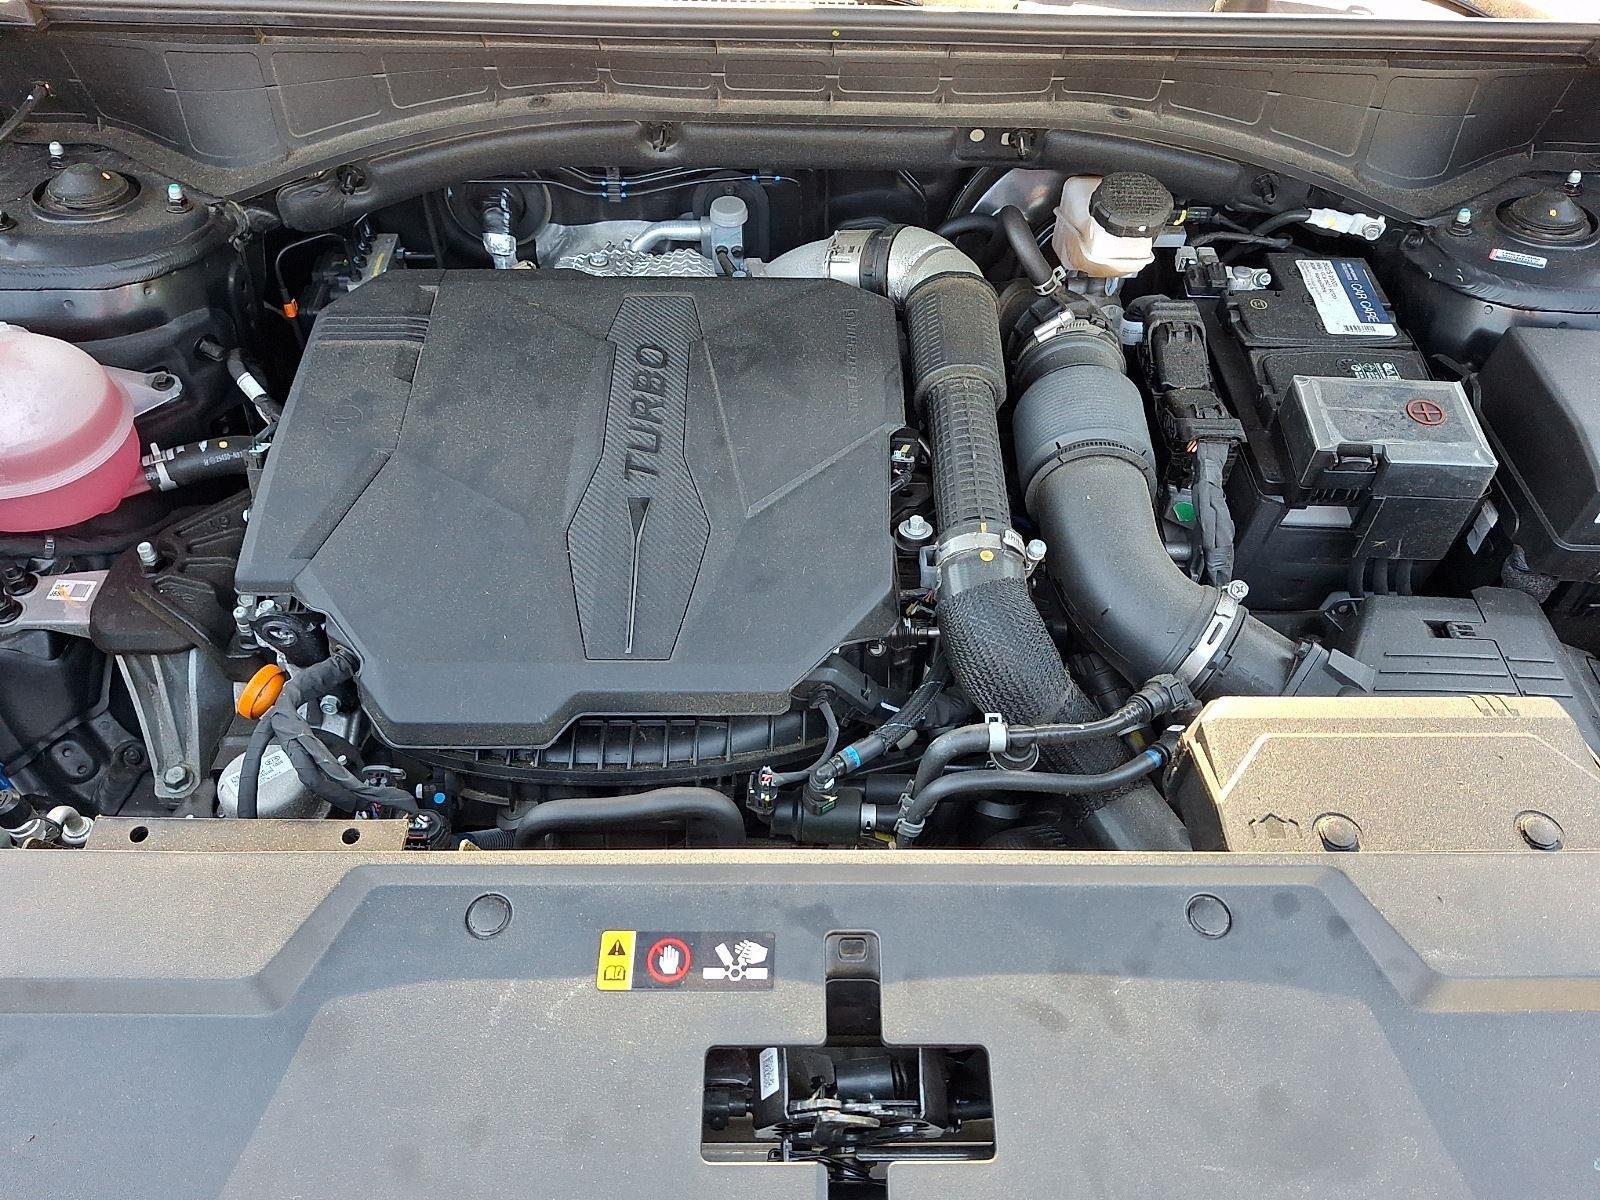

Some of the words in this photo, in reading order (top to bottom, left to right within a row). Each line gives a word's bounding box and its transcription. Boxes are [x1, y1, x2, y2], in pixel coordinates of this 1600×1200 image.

[1351, 283, 1368, 300] CAR
[1360, 300, 1381, 322] CARE
[624, 344, 669, 481] TURBO
